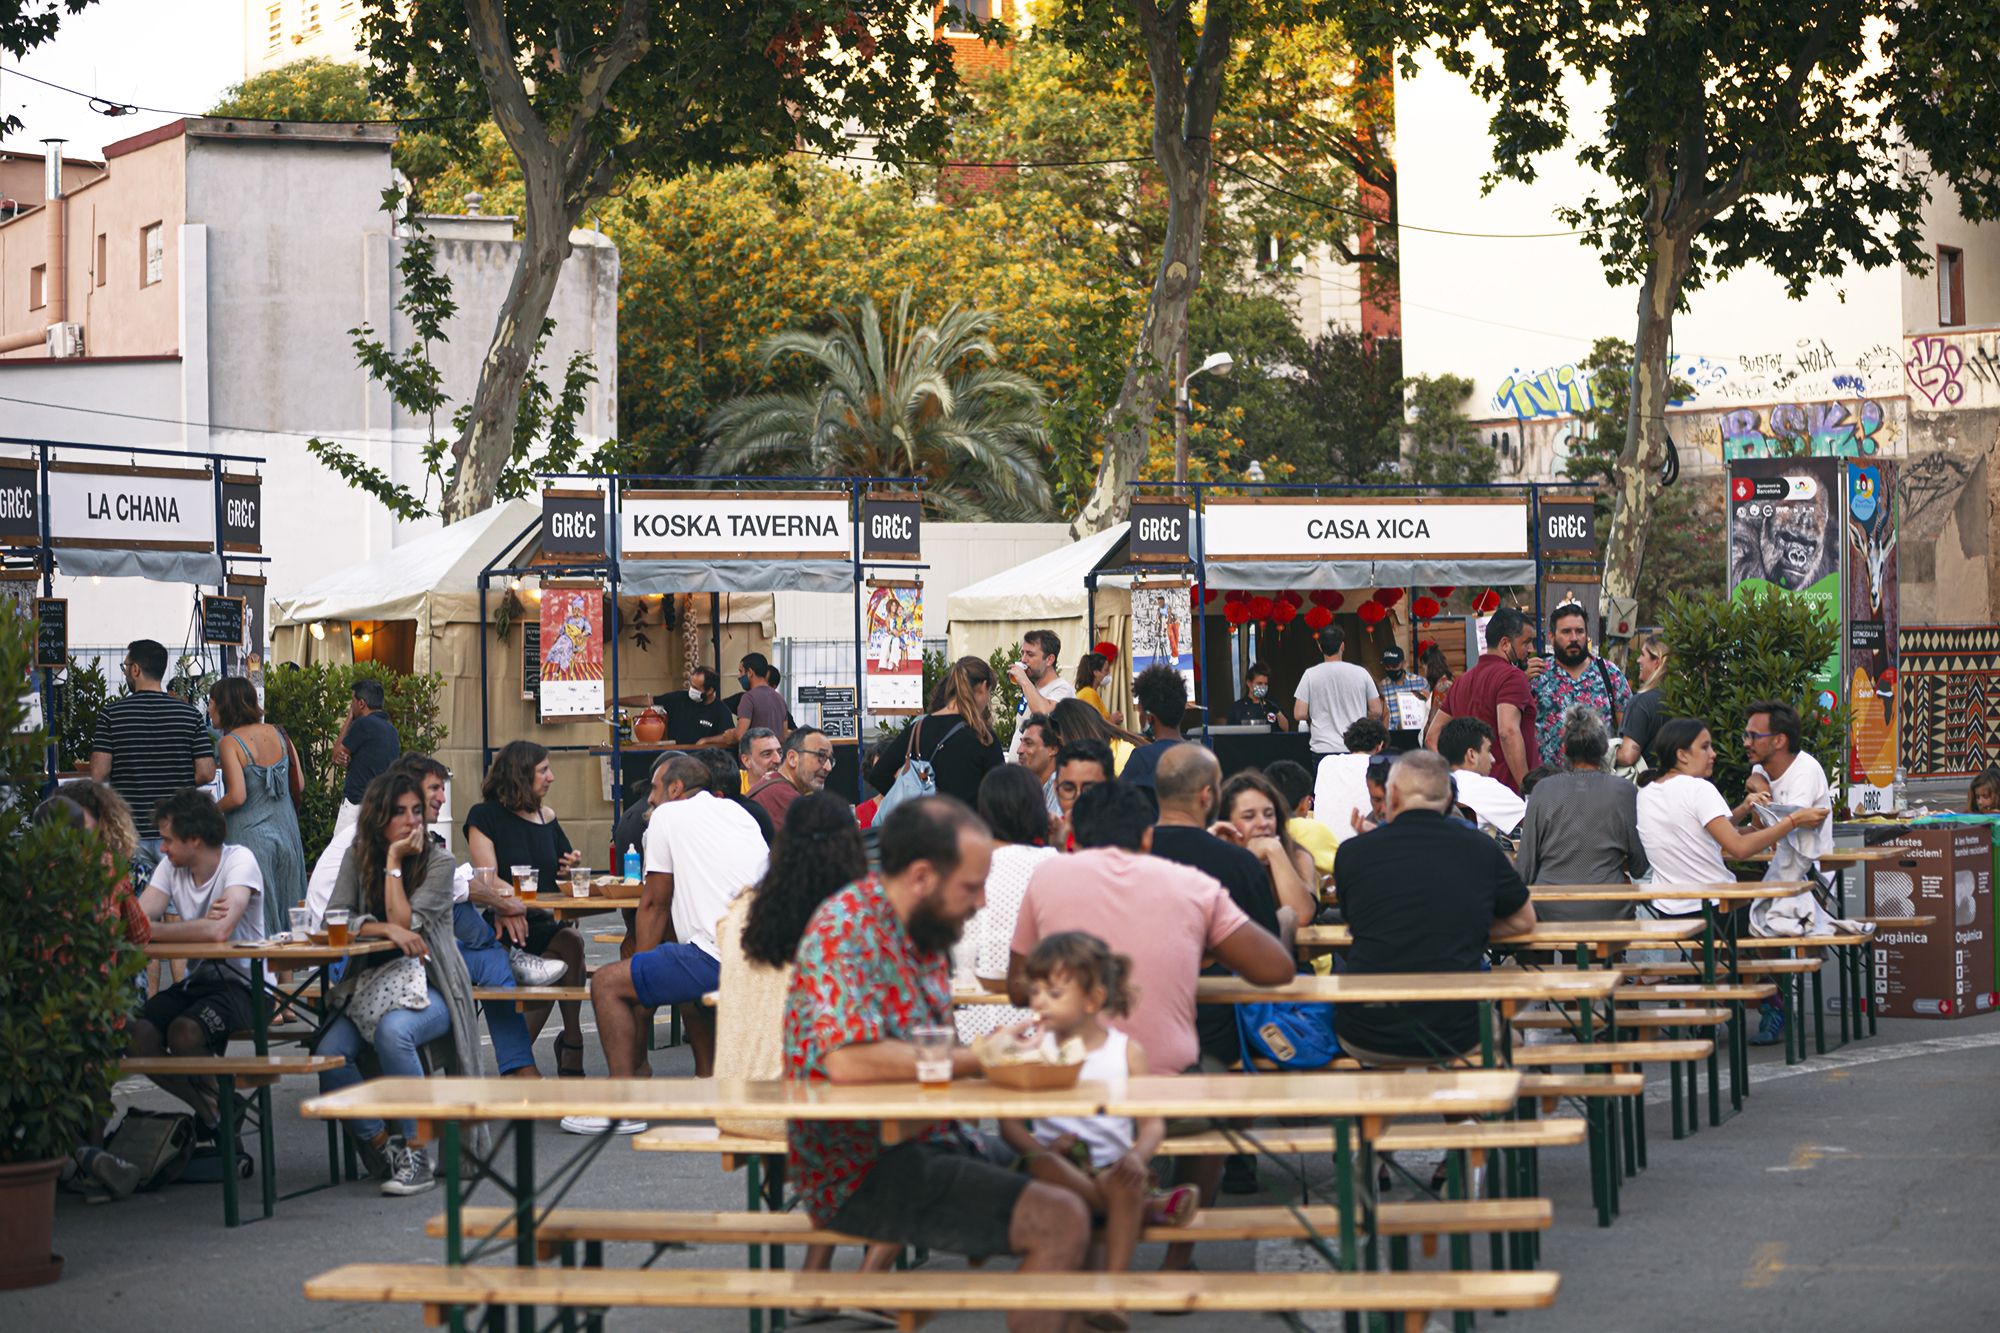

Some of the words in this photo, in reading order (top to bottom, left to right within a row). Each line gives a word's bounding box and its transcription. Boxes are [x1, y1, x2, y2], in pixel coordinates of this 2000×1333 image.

[1796, 338, 1836, 373] HOLA
[87, 492, 111, 520] LA
[116, 493, 180, 523] CHANA
[633, 514, 722, 537] KOSKA
[727, 514, 840, 537] TAVERNA
[1307, 518, 1371, 540] CASA
[1376, 518, 1431, 539] XICA
[1895, 837, 1922, 847] festes
[1955, 929, 1983, 945] Orgànica
